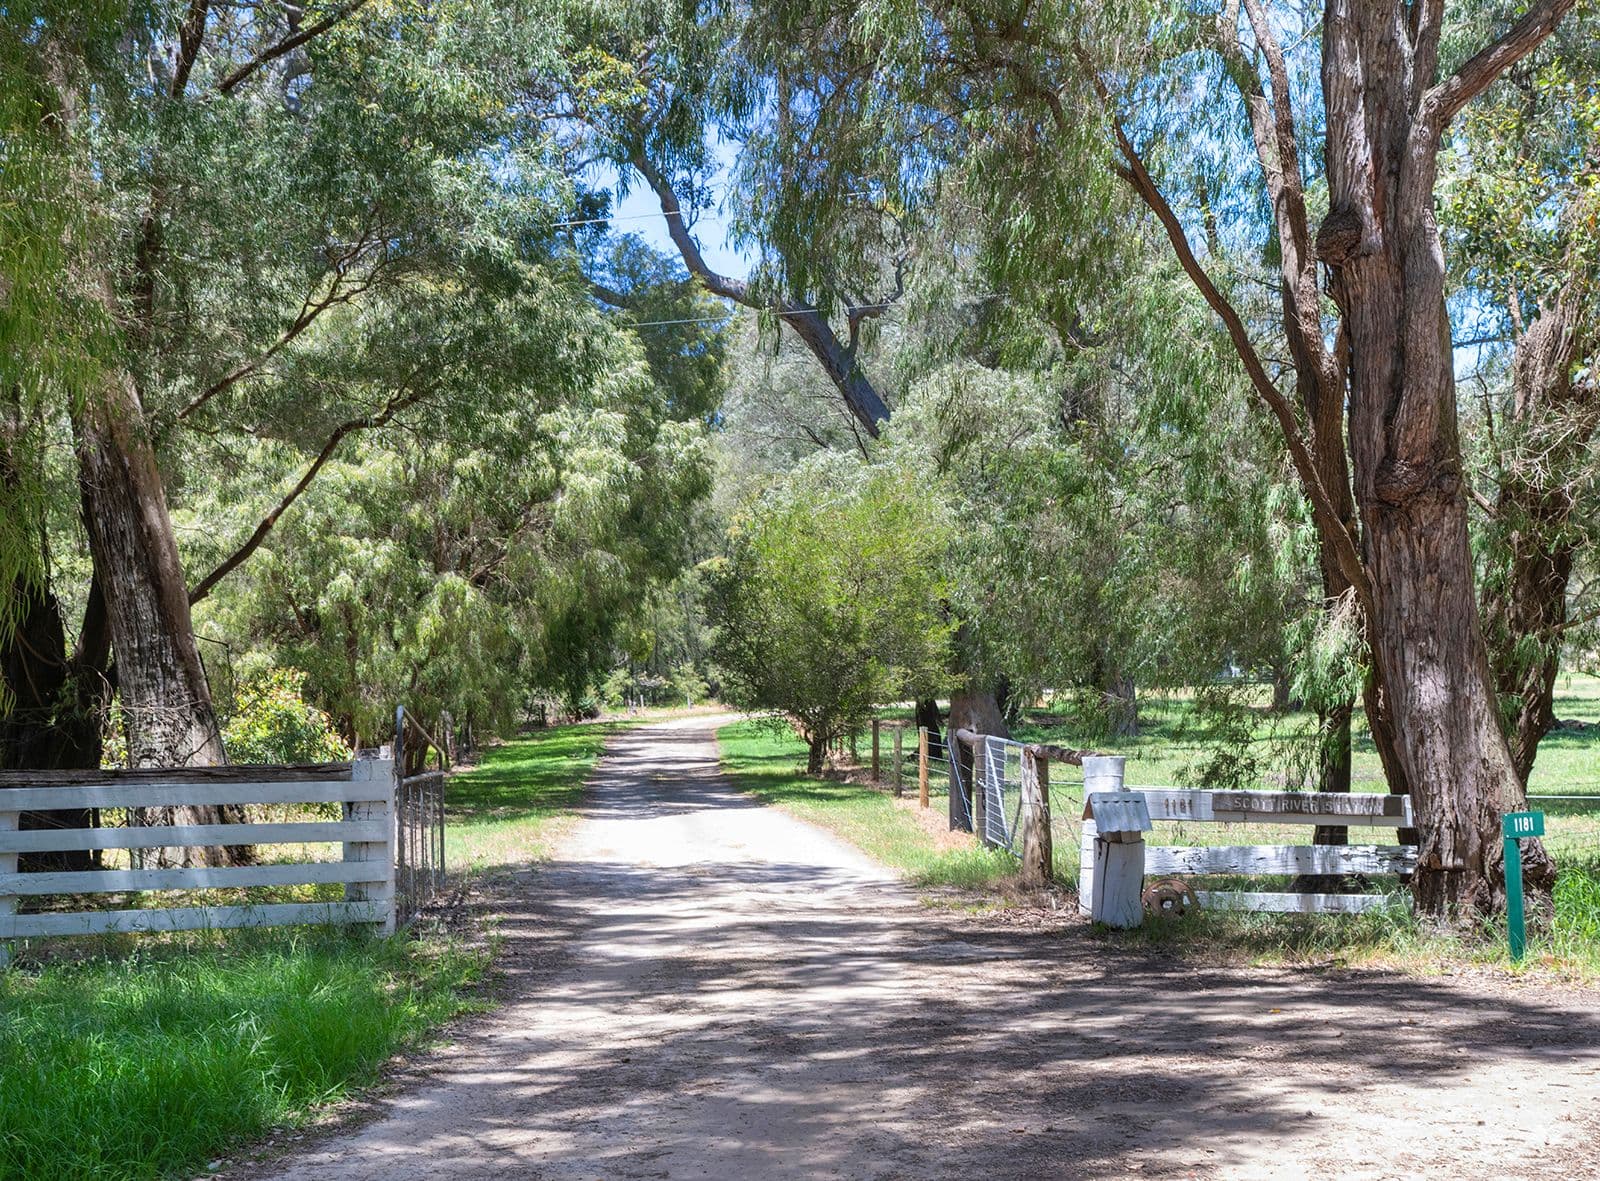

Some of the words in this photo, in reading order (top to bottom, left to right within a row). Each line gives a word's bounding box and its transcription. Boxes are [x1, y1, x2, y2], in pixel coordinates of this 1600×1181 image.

[1234, 797, 1275, 811] SCOTT
[1282, 799, 1319, 813] RIVER
[1514, 817, 1534, 832] 1181
